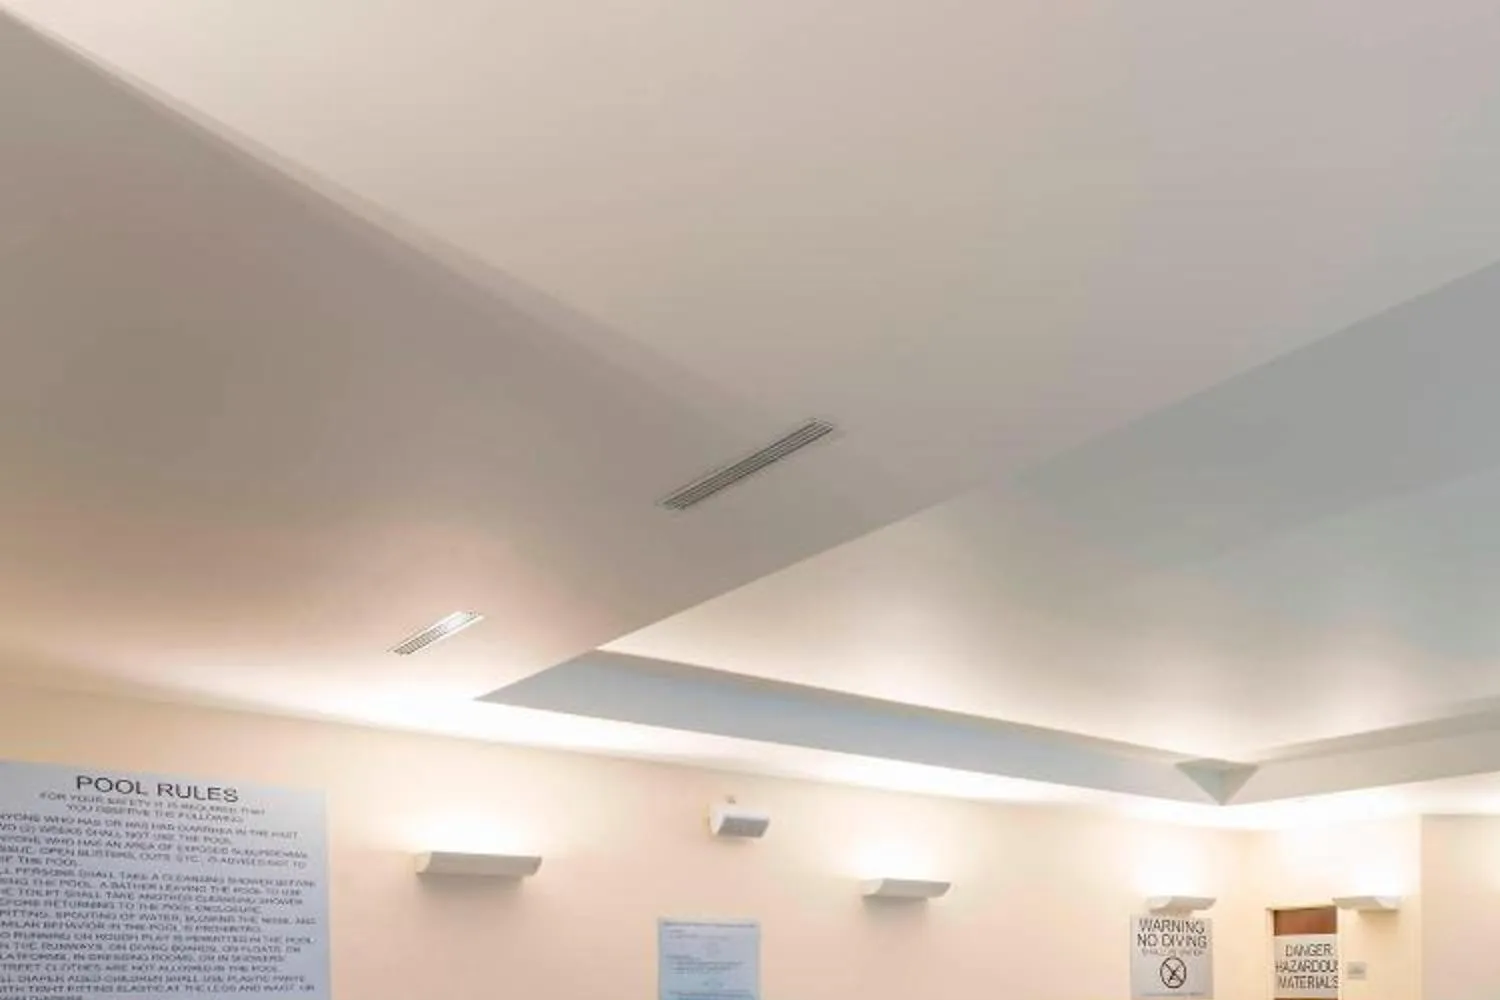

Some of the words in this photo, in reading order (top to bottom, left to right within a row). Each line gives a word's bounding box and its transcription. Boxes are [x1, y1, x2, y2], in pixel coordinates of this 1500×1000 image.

[76, 775, 148, 796] POOL
[157, 783, 239, 803] RULES
[1139, 918, 1205, 934] WARNING
[1137, 934, 1158, 947] NO
[1162, 934, 1207, 949] DIVING
[1285, 943, 1332, 957] DANGER
[1277, 976, 1339, 990] MATERIALS
